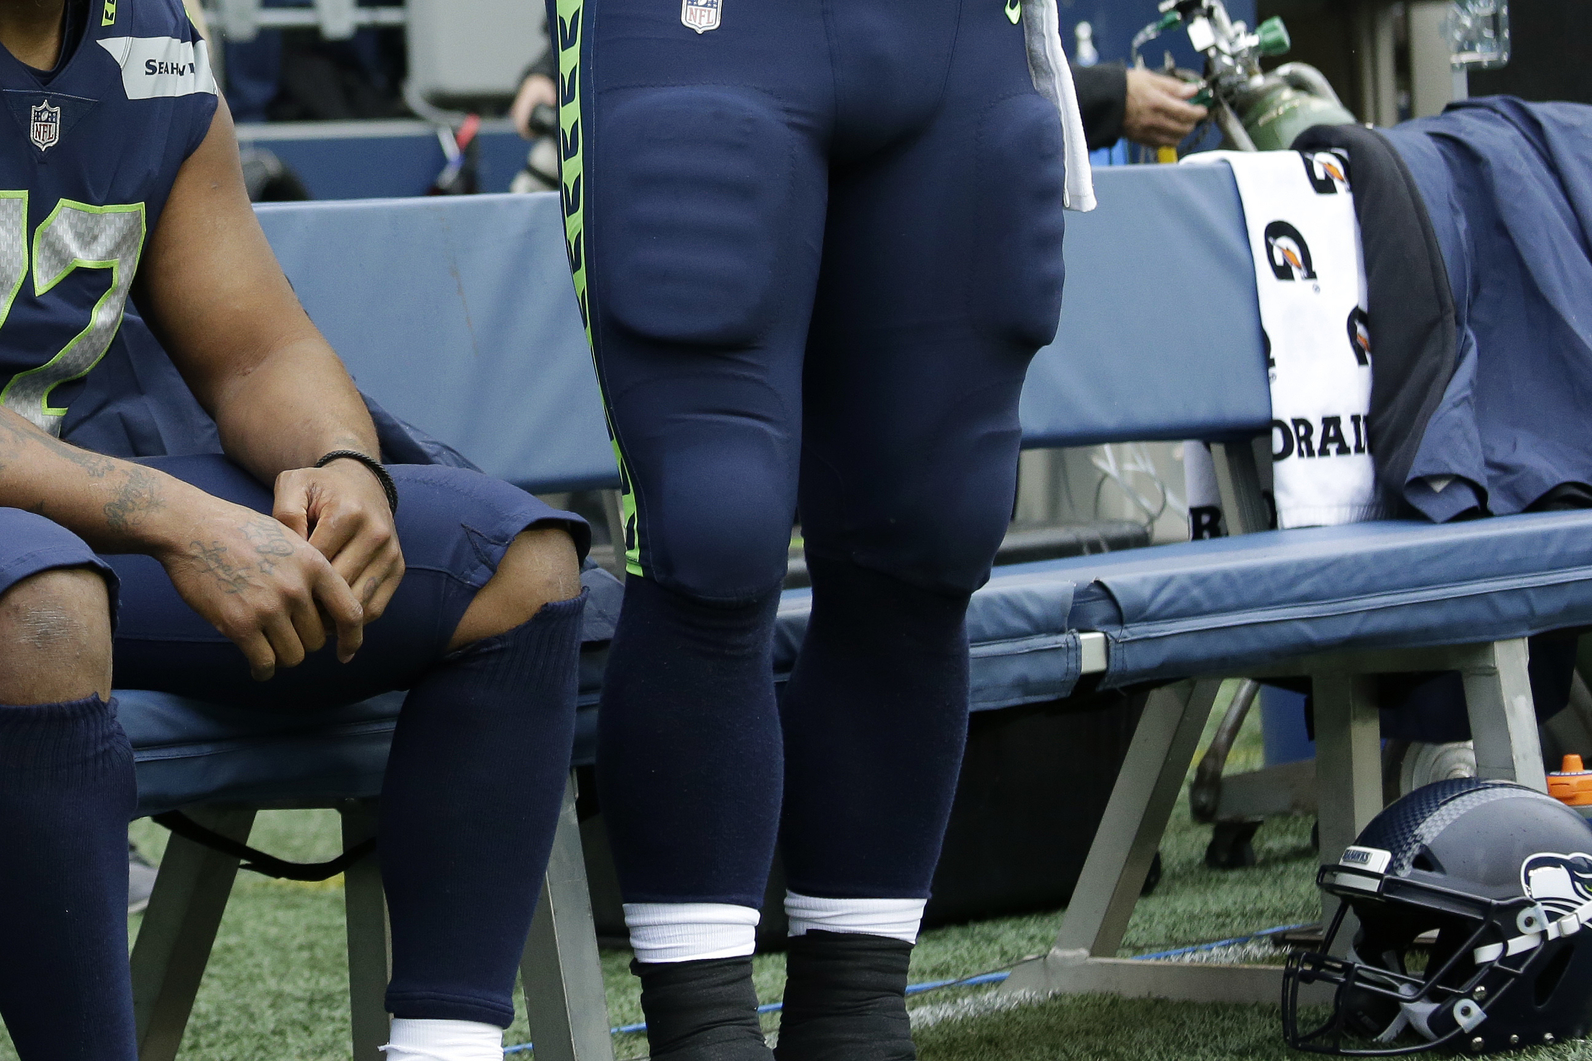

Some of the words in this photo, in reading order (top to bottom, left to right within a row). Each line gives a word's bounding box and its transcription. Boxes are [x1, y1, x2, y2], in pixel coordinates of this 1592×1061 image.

[688, 7, 714, 26] NFL
[33, 124, 55, 142] NFL
[1264, 220, 1318, 281] G
